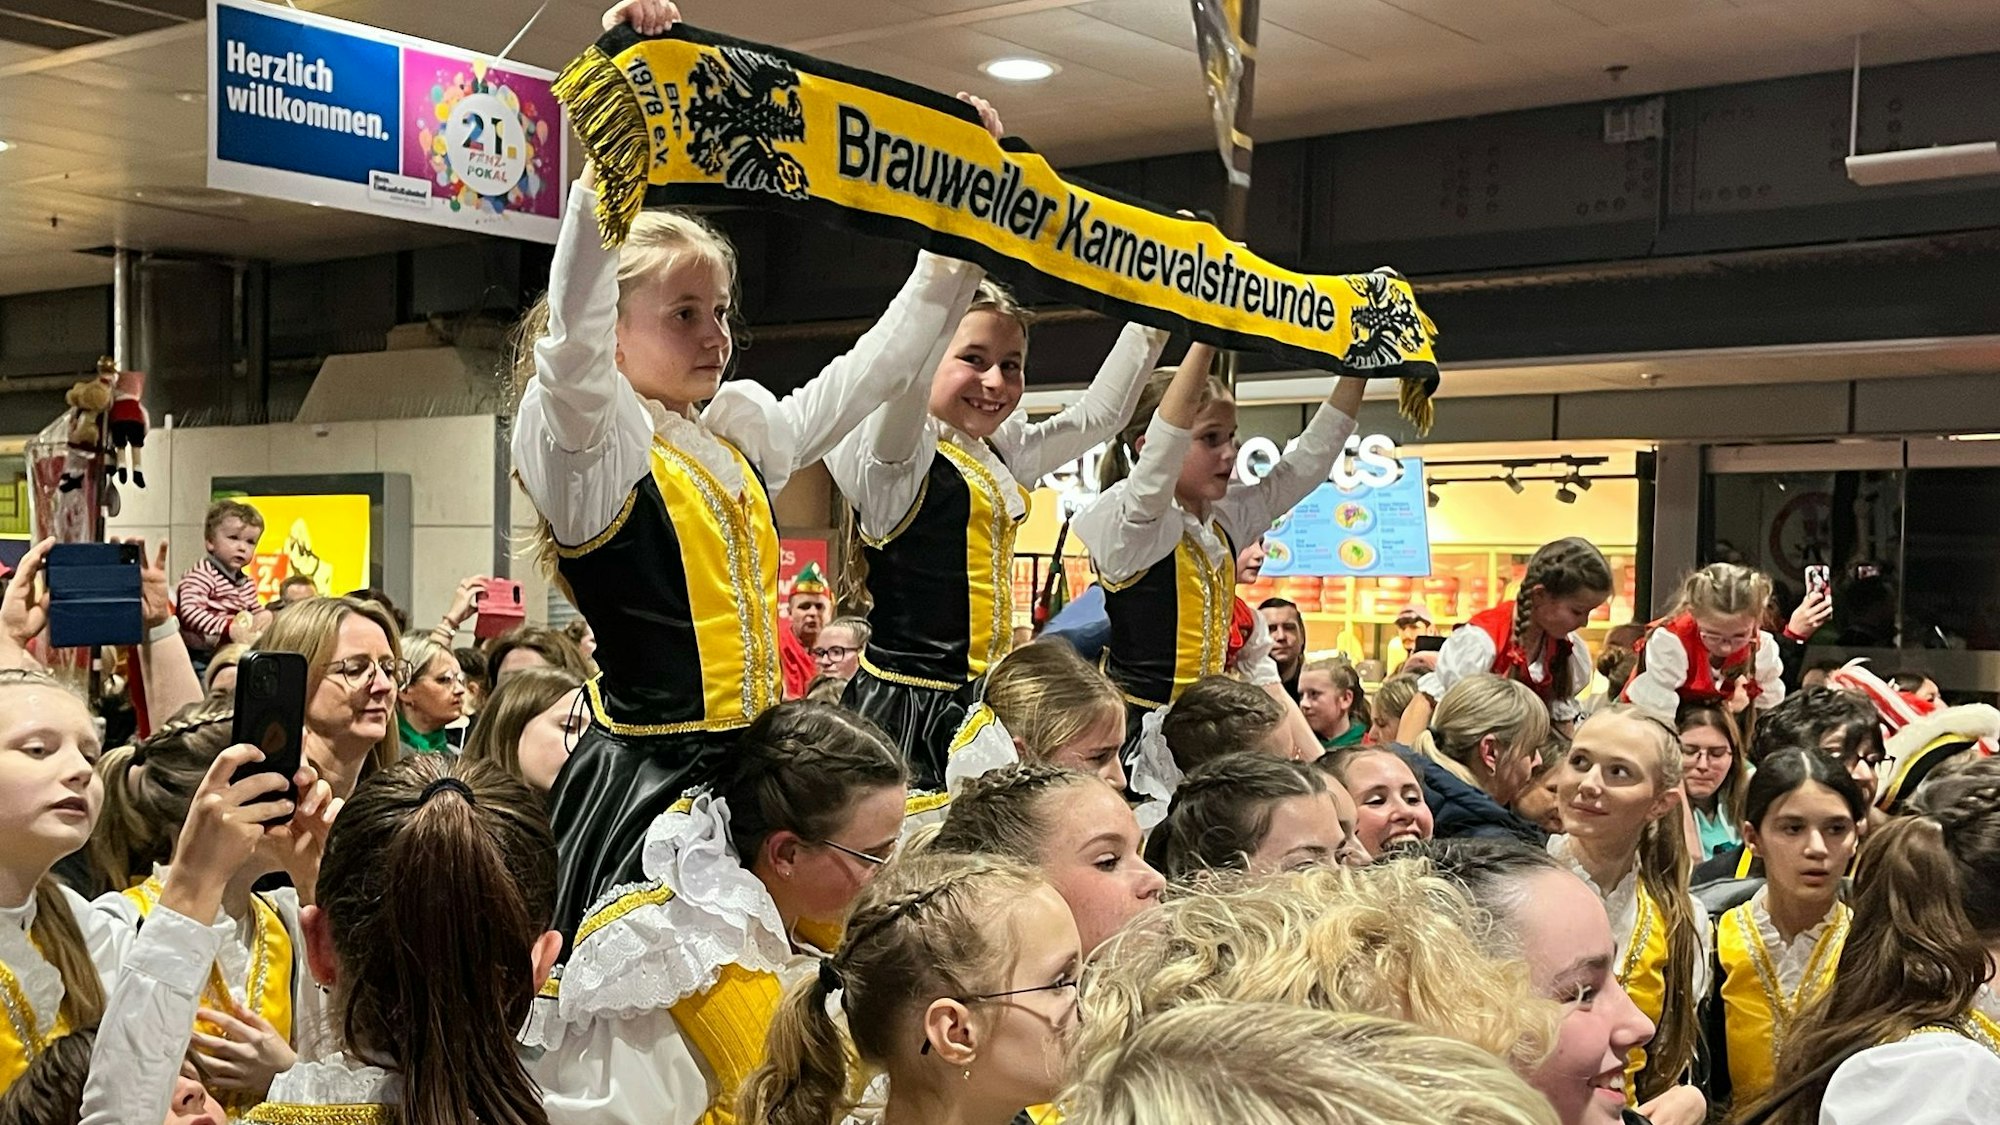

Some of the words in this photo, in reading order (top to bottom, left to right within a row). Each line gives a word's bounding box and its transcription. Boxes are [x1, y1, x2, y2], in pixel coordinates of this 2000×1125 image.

[227, 40, 333, 93] Herzlich
[628, 59, 664, 115] 1978
[226, 81, 389, 141] willkommen.
[467, 165, 508, 182] POKAL
[838, 104, 1058, 241] Brauweiler
[1057, 191, 1336, 332] Karnevalsfreunde
